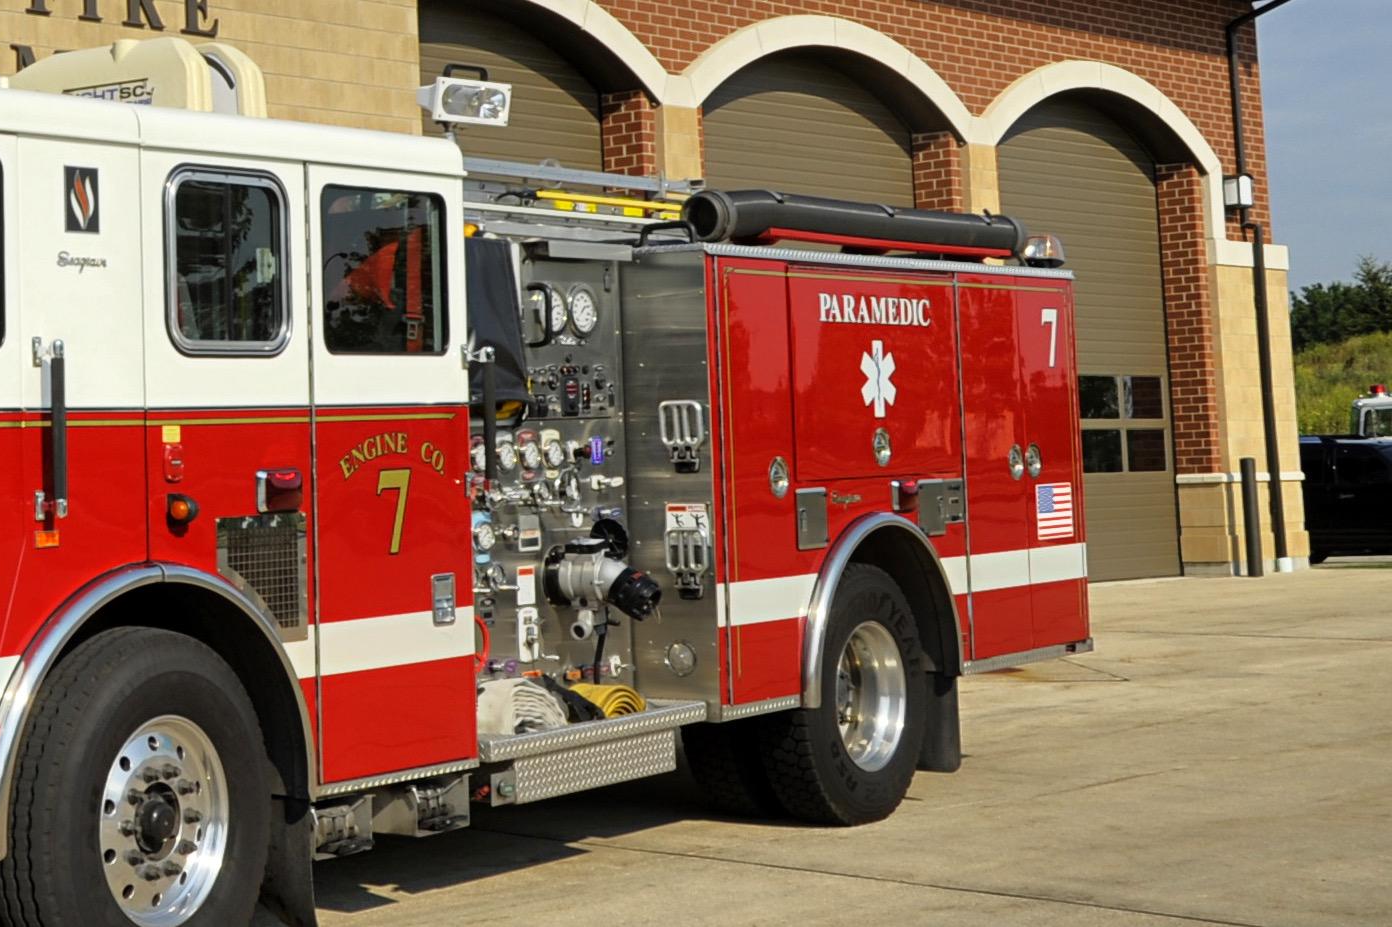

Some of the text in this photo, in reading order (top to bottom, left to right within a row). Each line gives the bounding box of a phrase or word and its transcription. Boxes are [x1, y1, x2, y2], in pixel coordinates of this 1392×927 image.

[818, 293, 931, 327] PARAMEDIC
[1040, 308, 1057, 368] 7
[339, 432, 446, 479] ENGINE CO.
[376, 467, 412, 554] 7
